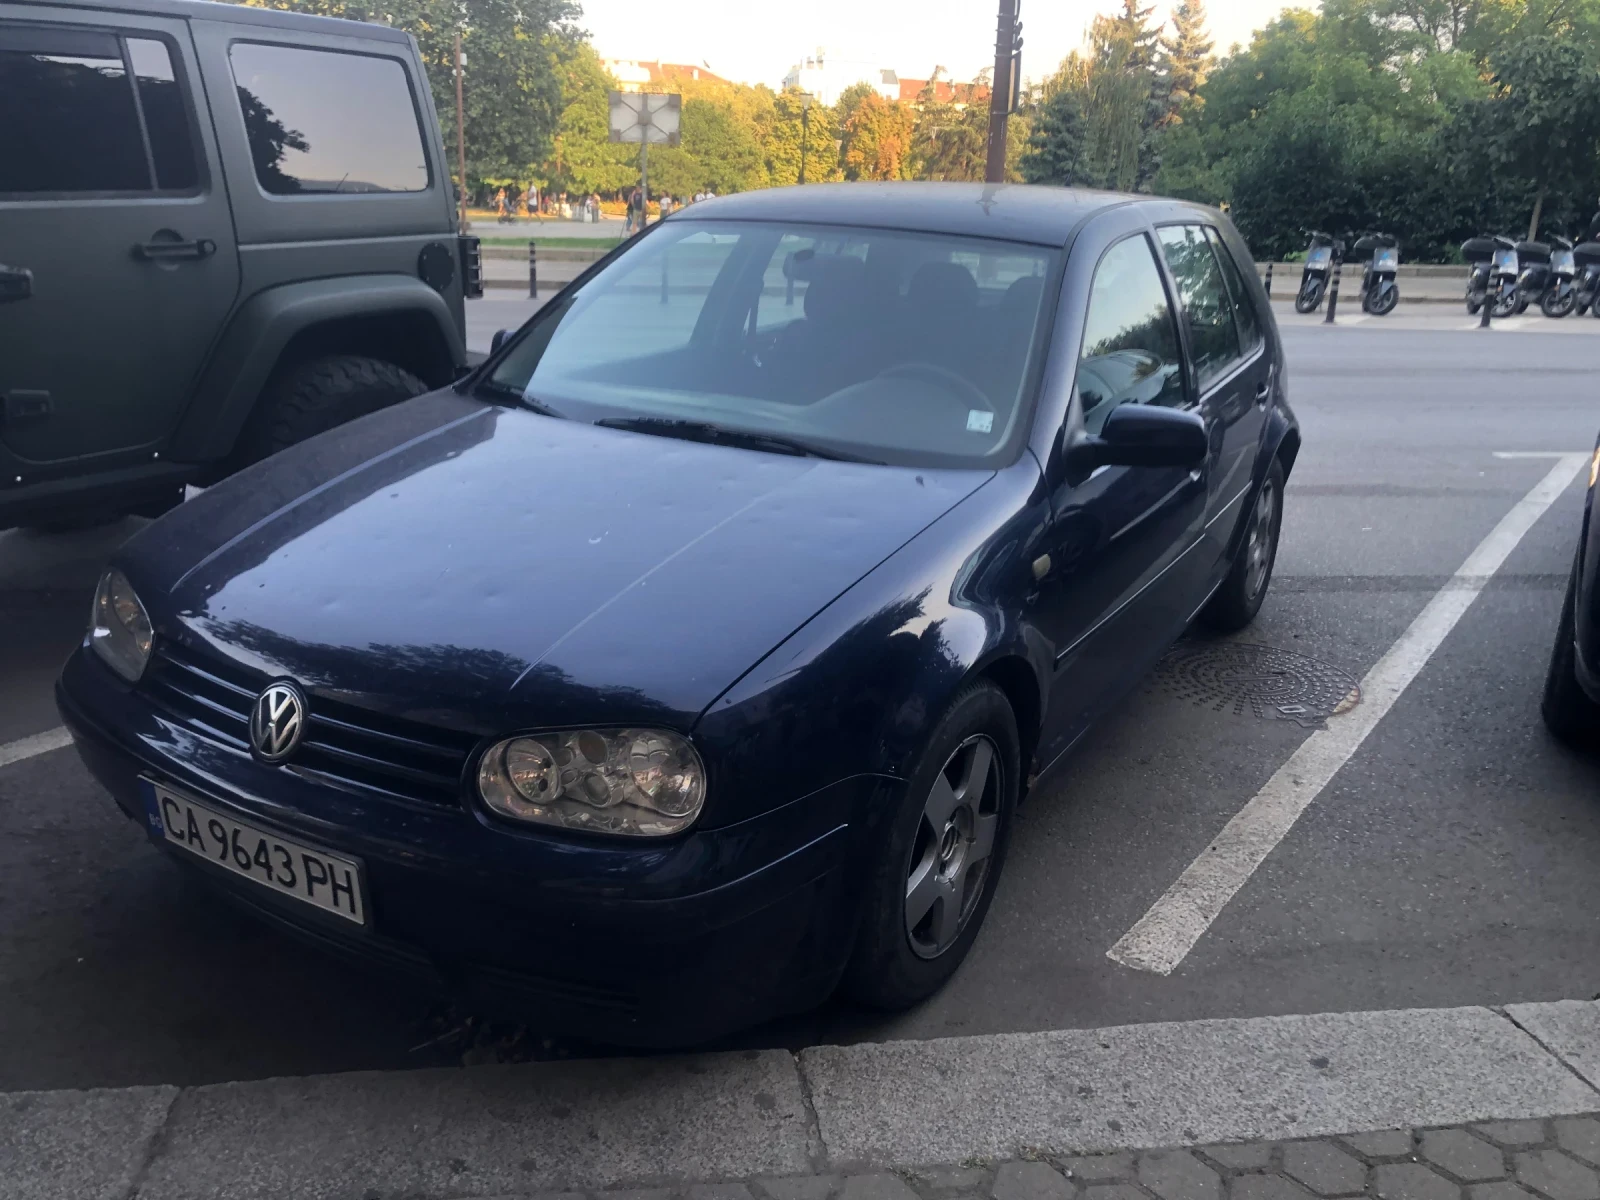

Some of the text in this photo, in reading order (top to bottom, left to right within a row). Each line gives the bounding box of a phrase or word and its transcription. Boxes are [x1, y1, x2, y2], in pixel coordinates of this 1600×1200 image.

[162, 797, 356, 913] CA 9643 PH
